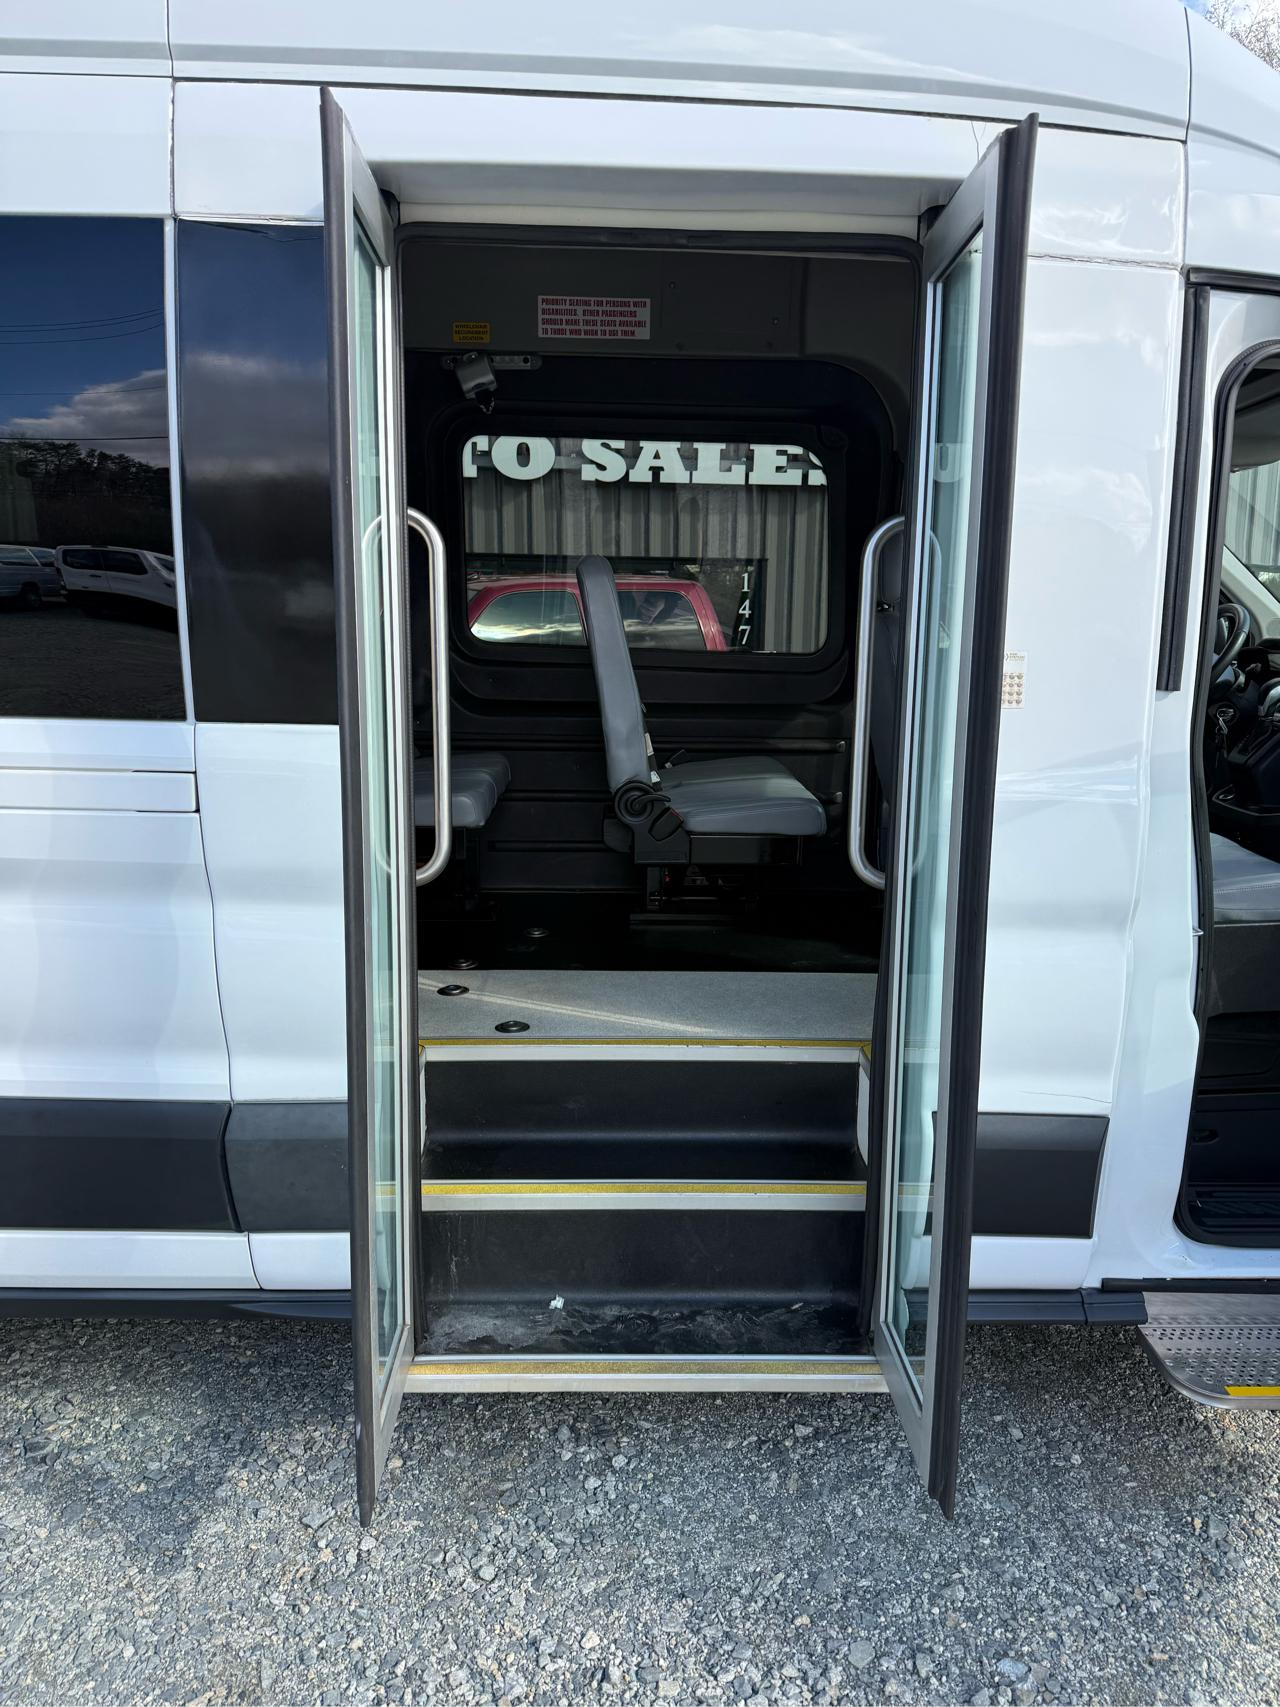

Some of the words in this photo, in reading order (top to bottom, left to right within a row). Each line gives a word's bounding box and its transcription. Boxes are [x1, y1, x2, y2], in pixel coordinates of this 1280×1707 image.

[541, 298, 567, 306] PRIORITY
[568, 298, 592, 307] SEATING
[593, 299, 604, 307] FOR
[605, 299, 631, 308] PERSONS
[632, 300, 647, 309] WITH
[582, 309, 600, 317] OTHER
[601, 309, 638, 318] PASSENGERS
[541, 318, 564, 326] SHOULD
[564, 318, 581, 327] MAKE
[582, 318, 598, 327] THESE
[599, 319, 617, 328] SEATS
[618, 319, 647, 328] AVAILABLE
[541, 328, 549, 336] TO
[550, 328, 567, 336] THOSE
[568, 328, 582, 337] WHO
[583, 328, 599, 337] WISH
[600, 329, 607, 337] TO
[608, 329, 619, 337] USE
